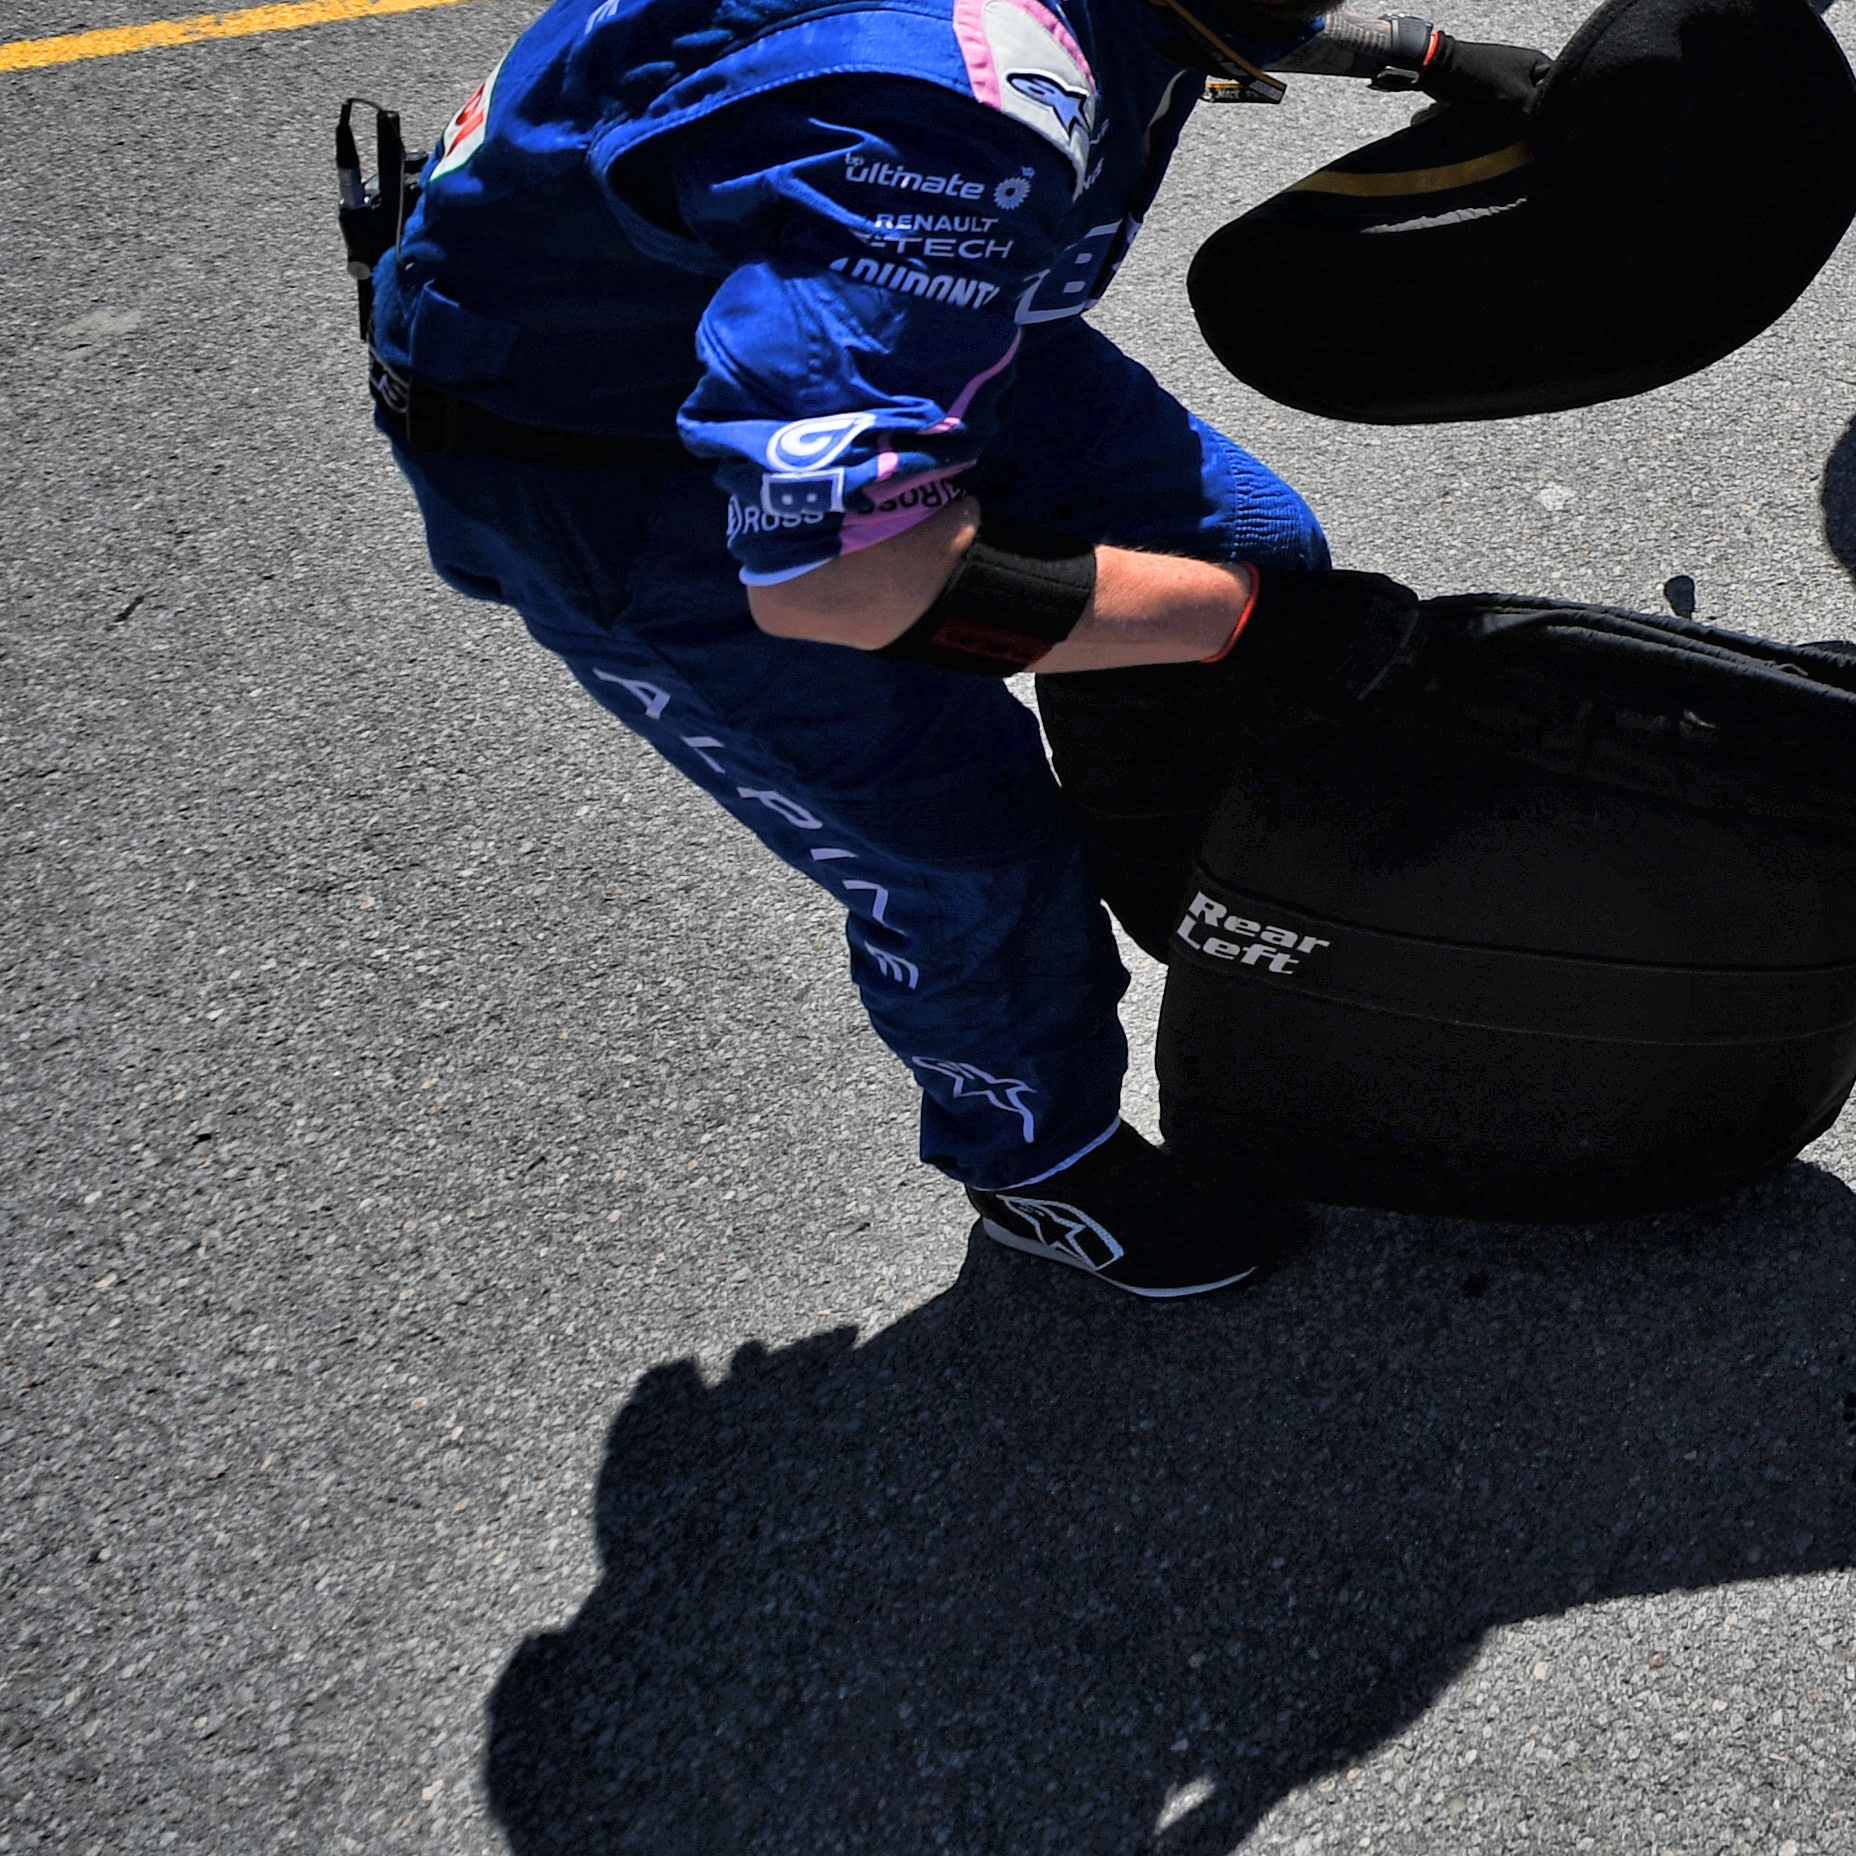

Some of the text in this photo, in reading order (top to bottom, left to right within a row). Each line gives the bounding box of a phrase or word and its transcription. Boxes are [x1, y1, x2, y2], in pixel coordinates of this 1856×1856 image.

[846, 162, 986, 201] ultimate
[874, 213, 999, 234] RENAULT
[594, 668, 920, 991] ALPINE
[1177, 914, 1300, 975] Left
[1188, 890, 1331, 955] Rear
